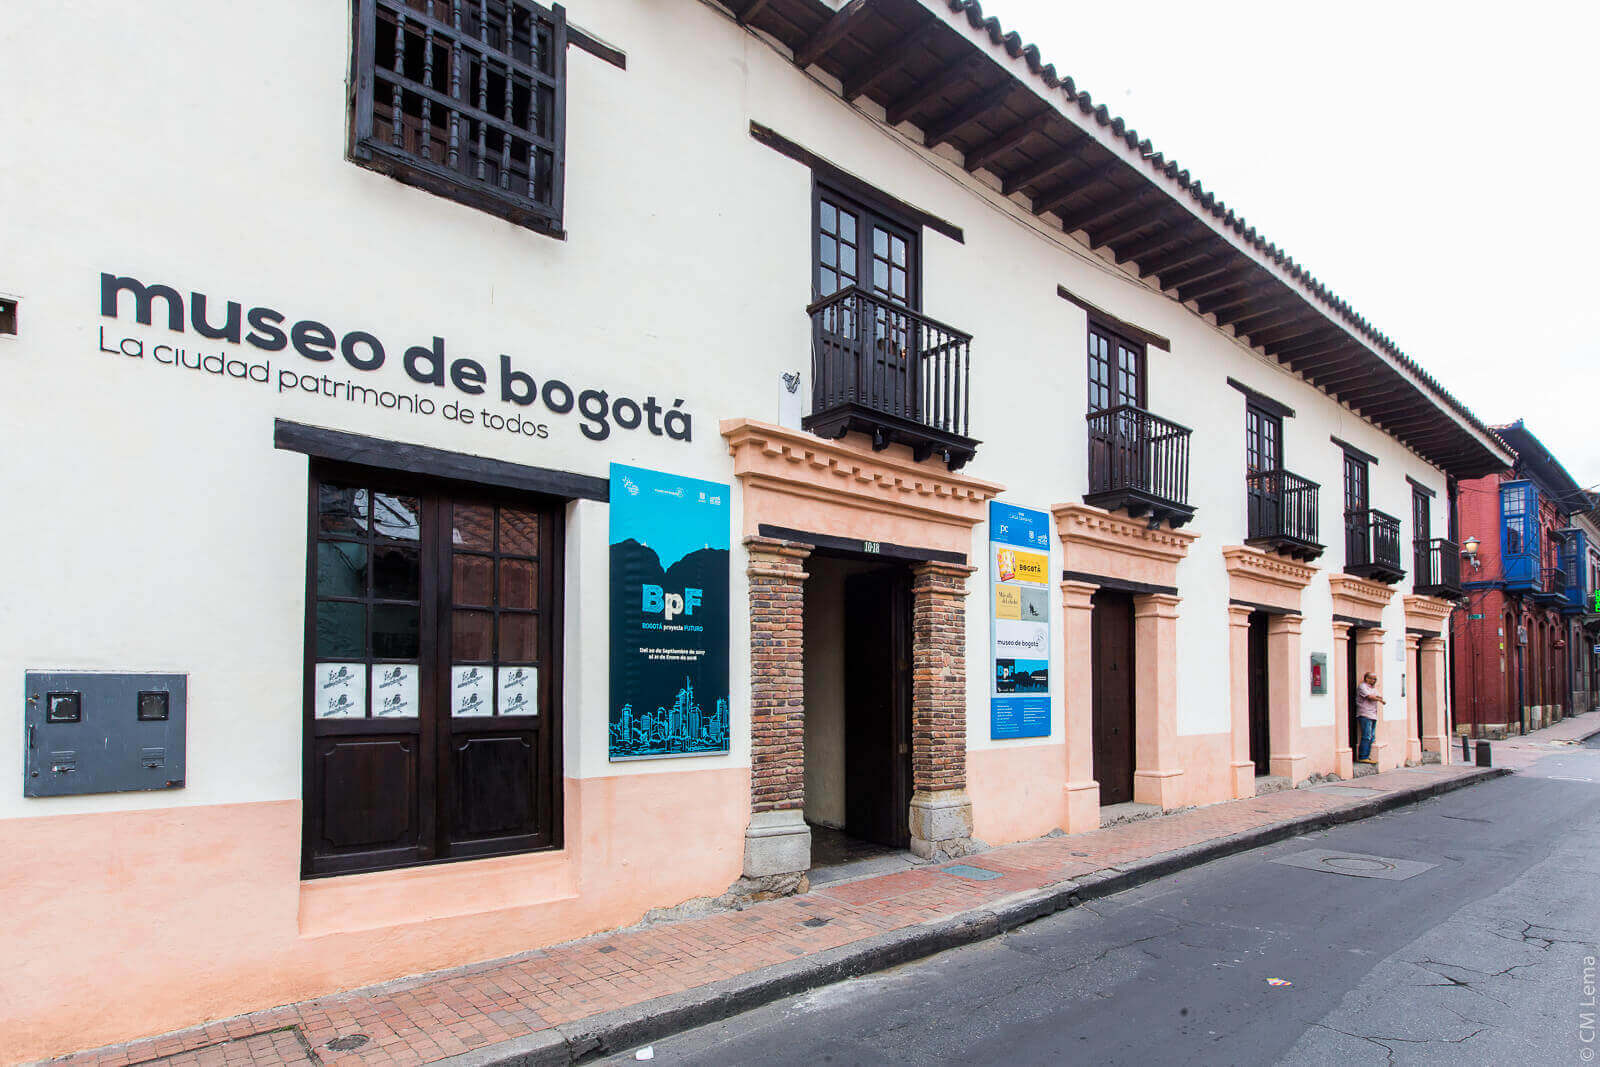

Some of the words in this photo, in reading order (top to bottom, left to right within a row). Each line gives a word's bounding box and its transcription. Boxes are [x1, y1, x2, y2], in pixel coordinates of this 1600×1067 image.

[100, 272, 386, 372] museo
[403, 336, 487, 396] de
[500, 355, 692, 442] bogotá
[99, 326, 144, 359] La
[153, 345, 270, 384] ciudad
[278, 369, 436, 415] patrimonio
[442, 400, 475, 425] de
[481, 409, 549, 439] todos
[864, 541, 880, 553] 10-18
[642, 583, 704, 620] BpF
[641, 622, 663, 630] BOGOTÁ
